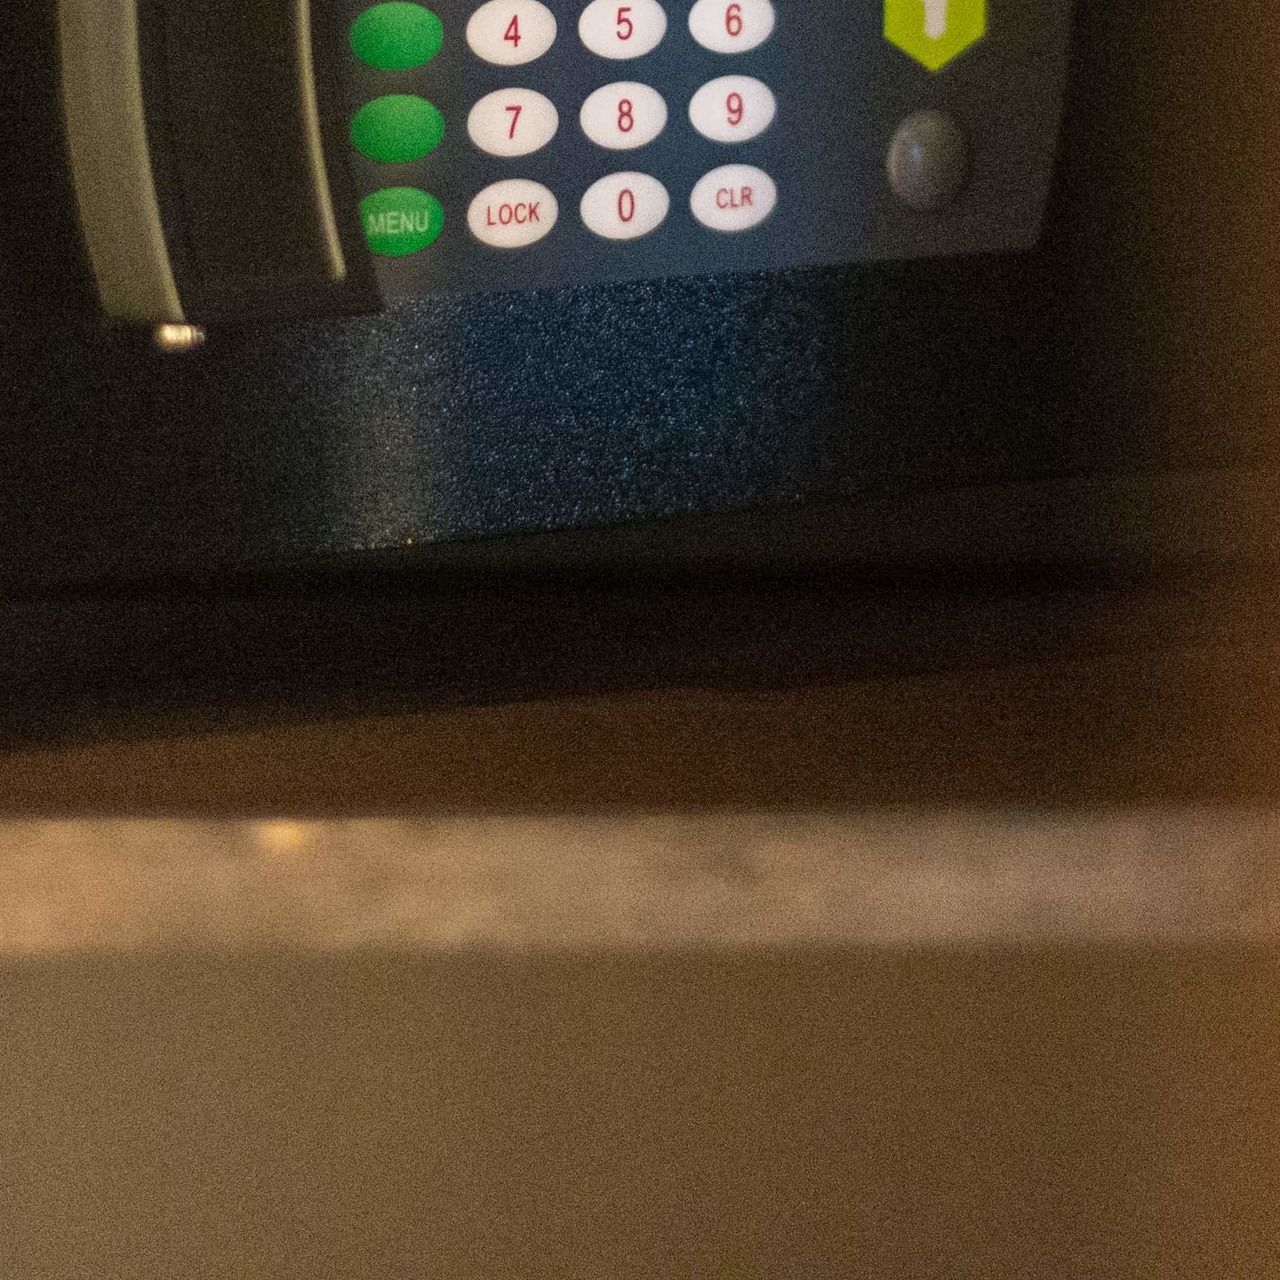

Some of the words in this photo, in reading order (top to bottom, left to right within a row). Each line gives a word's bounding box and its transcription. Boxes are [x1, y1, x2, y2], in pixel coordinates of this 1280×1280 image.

[503, 15, 521, 48] 4
[616, 7, 634, 41] 5
[725, 3, 743, 37] 6
[505, 105, 522, 139] 7
[617, 99, 634, 133] 8
[726, 92, 744, 126] 9
[486, 201, 541, 226] LOCK
[617, 189, 635, 222] 0
[716, 186, 753, 209] CLR
[367, 210, 430, 237] MENU
